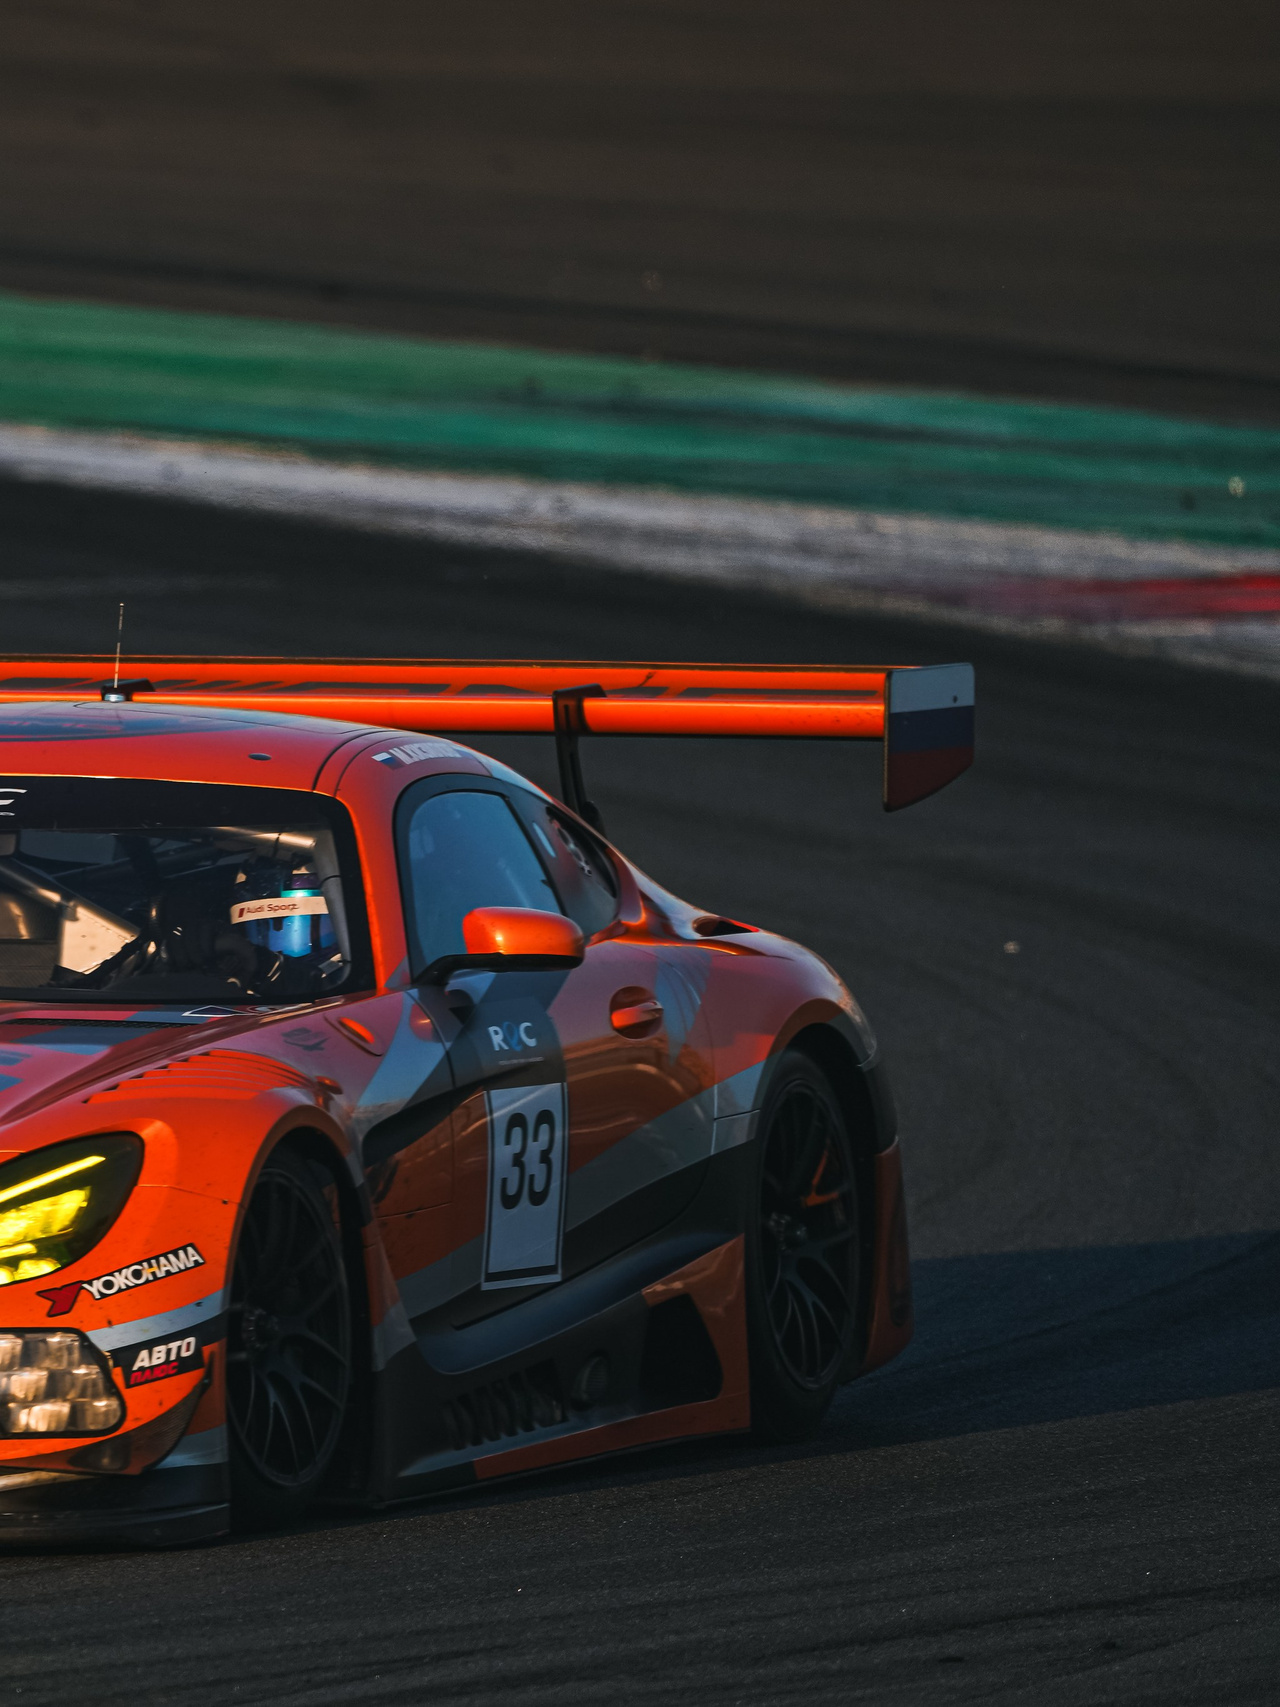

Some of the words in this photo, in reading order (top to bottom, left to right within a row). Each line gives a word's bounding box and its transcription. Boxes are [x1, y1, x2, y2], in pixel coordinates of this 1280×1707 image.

[501, 1109, 556, 1210] 33
[81, 1246, 205, 1300] YOKOHAMA
[129, 1362, 180, 1385] ПЛЮС
[132, 1336, 196, 1371] АВТО
